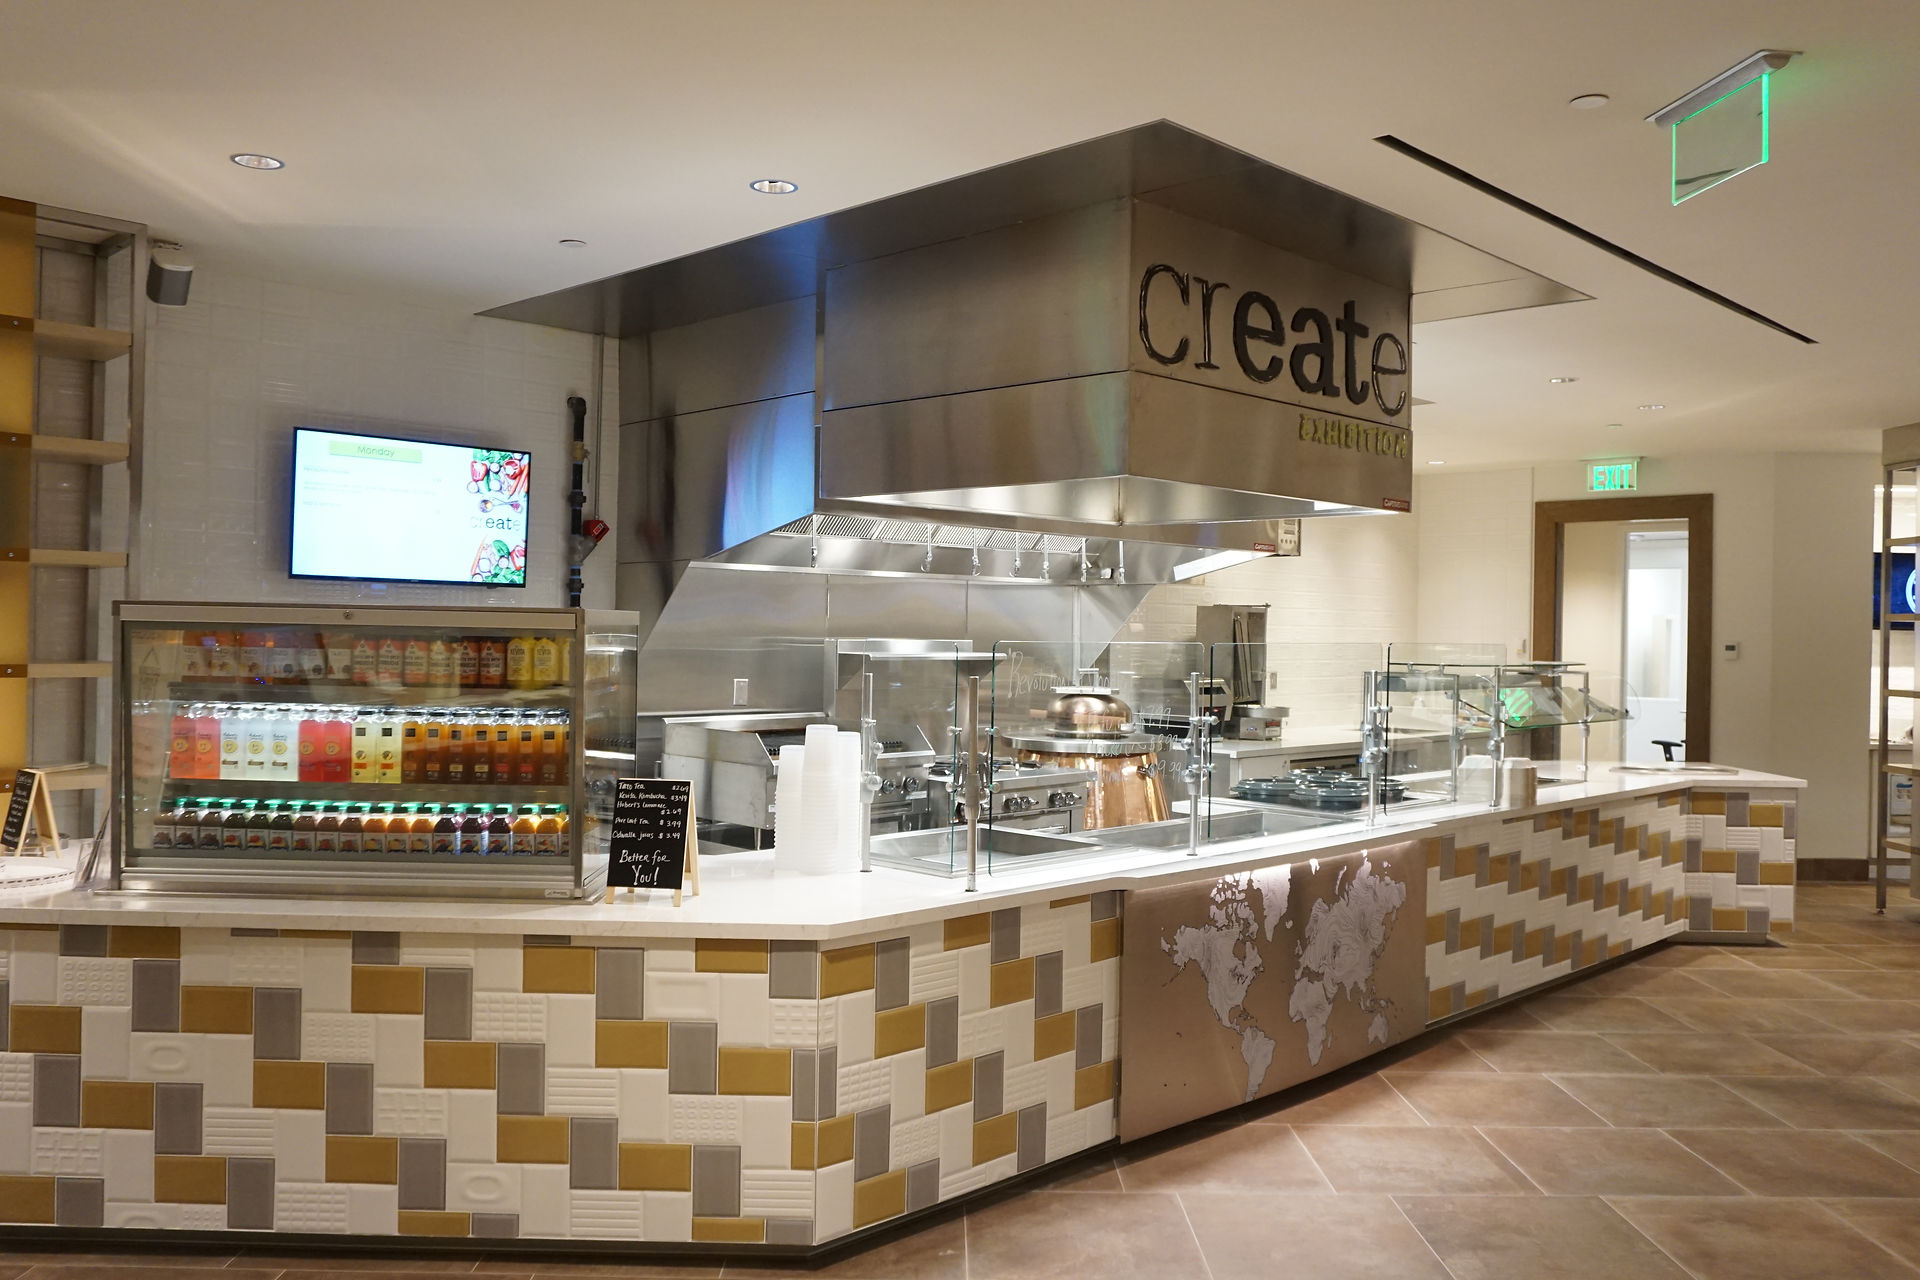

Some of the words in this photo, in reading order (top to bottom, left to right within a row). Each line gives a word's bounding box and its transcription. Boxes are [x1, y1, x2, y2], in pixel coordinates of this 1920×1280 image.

[1139, 263, 1407, 416] create
[1298, 413, 1409, 459] EXHIBITION
[356, 445, 396, 458] Monday
[1593, 464, 1633, 491] EXIT
[631, 864, 660, 886] You!
